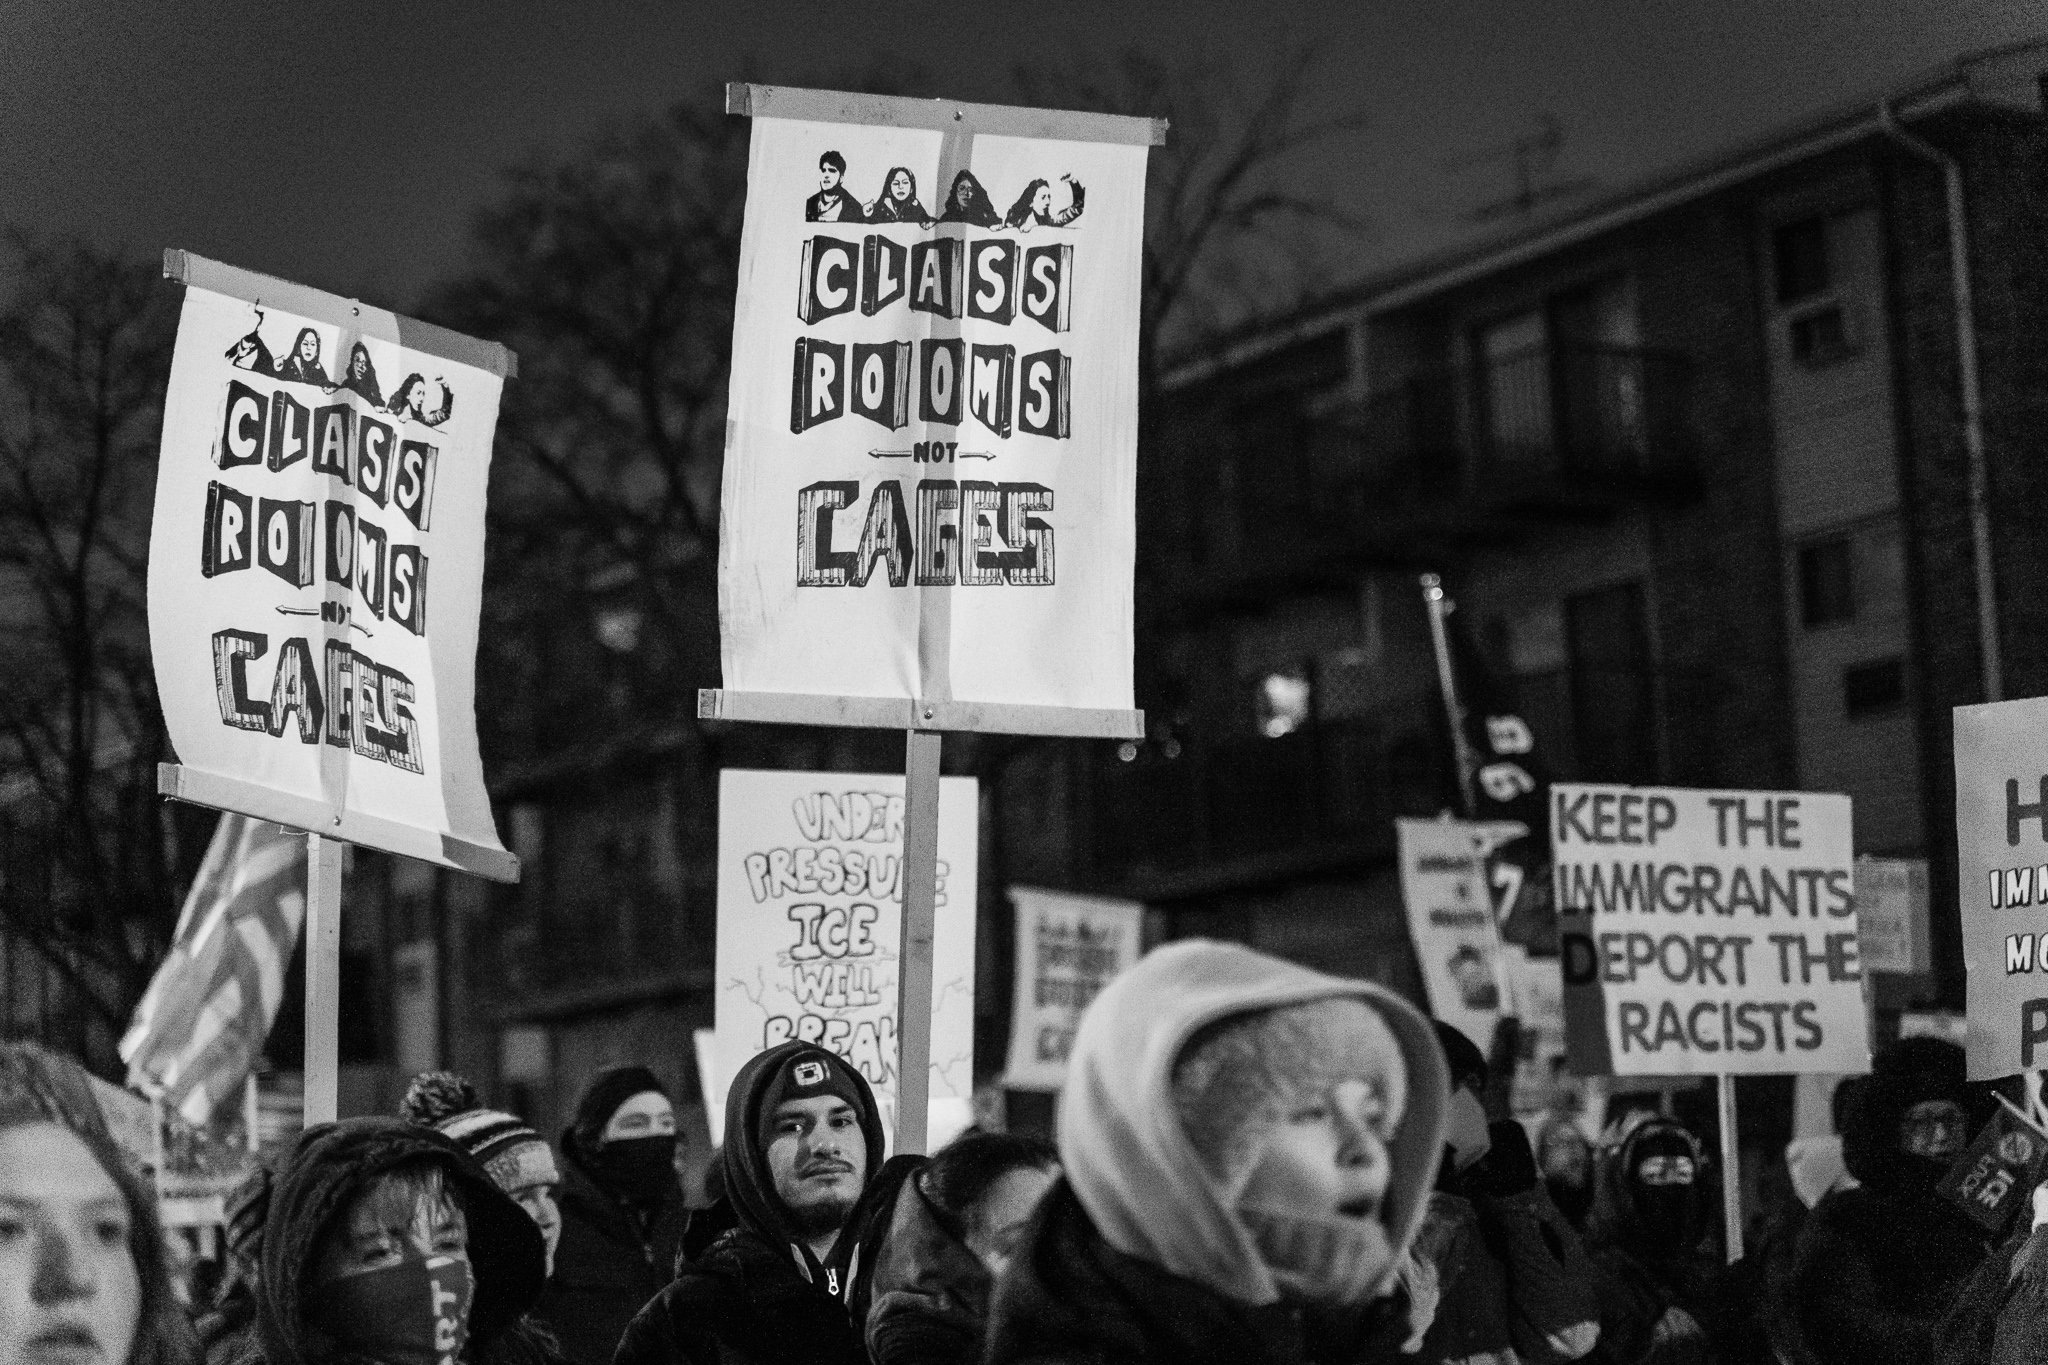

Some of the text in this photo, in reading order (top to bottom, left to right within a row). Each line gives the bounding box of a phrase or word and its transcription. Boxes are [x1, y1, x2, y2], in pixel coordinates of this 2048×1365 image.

[807, 241, 1066, 327] CLASS
[801, 344, 1062, 435] ROOMS
[220, 393, 428, 522] CLASS
[913, 441, 958, 465] NOT
[211, 495, 422, 630] ROOMS
[796, 479, 1056, 588] CAGES
[210, 627, 425, 776] CAGES
[1556, 793, 1802, 849] KEEP THE
[744, 847, 951, 908] PRESSUE
[1557, 862, 1858, 919] IMMIGRANTS
[788, 903, 879, 961] ICE
[1562, 931, 1863, 986] DEPORT THE
[792, 964, 881, 1009] WILL
[1619, 1001, 1824, 1053] RACISTS
